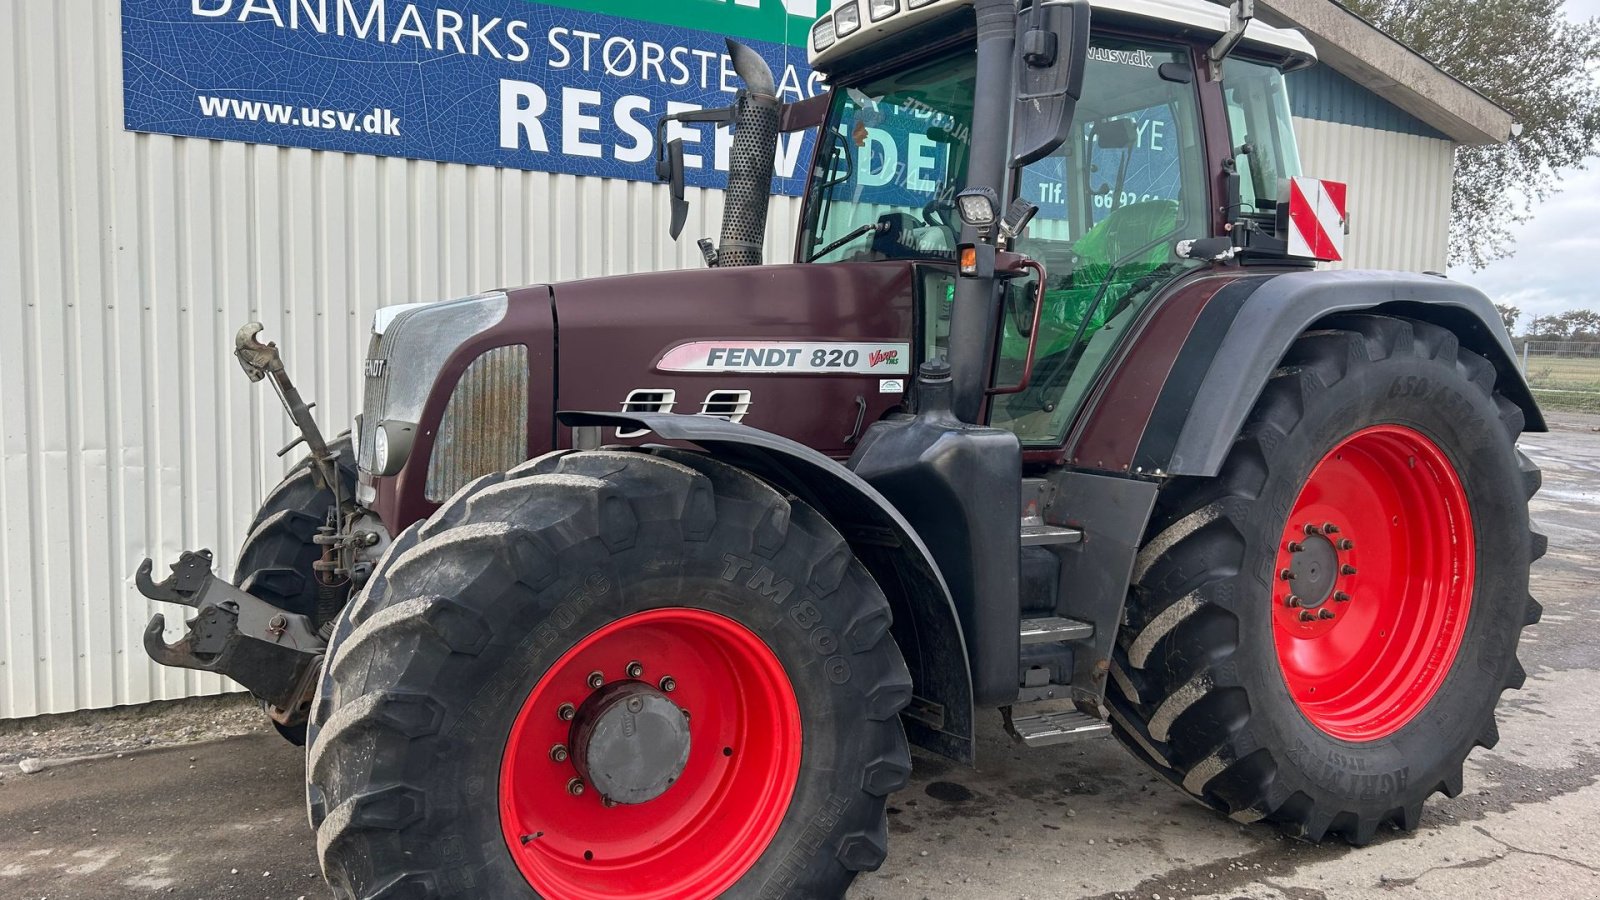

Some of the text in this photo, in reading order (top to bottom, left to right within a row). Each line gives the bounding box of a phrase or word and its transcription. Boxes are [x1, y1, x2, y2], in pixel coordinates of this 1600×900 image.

[548, 27, 739, 93] STØRSTE
[198, 95, 401, 137] www.usv.dk
[1039, 182, 1065, 204] Tlf.
[706, 348, 802, 367] FENDT
[810, 349, 859, 368] 820
[760, 793, 853, 900] TRELLEB
